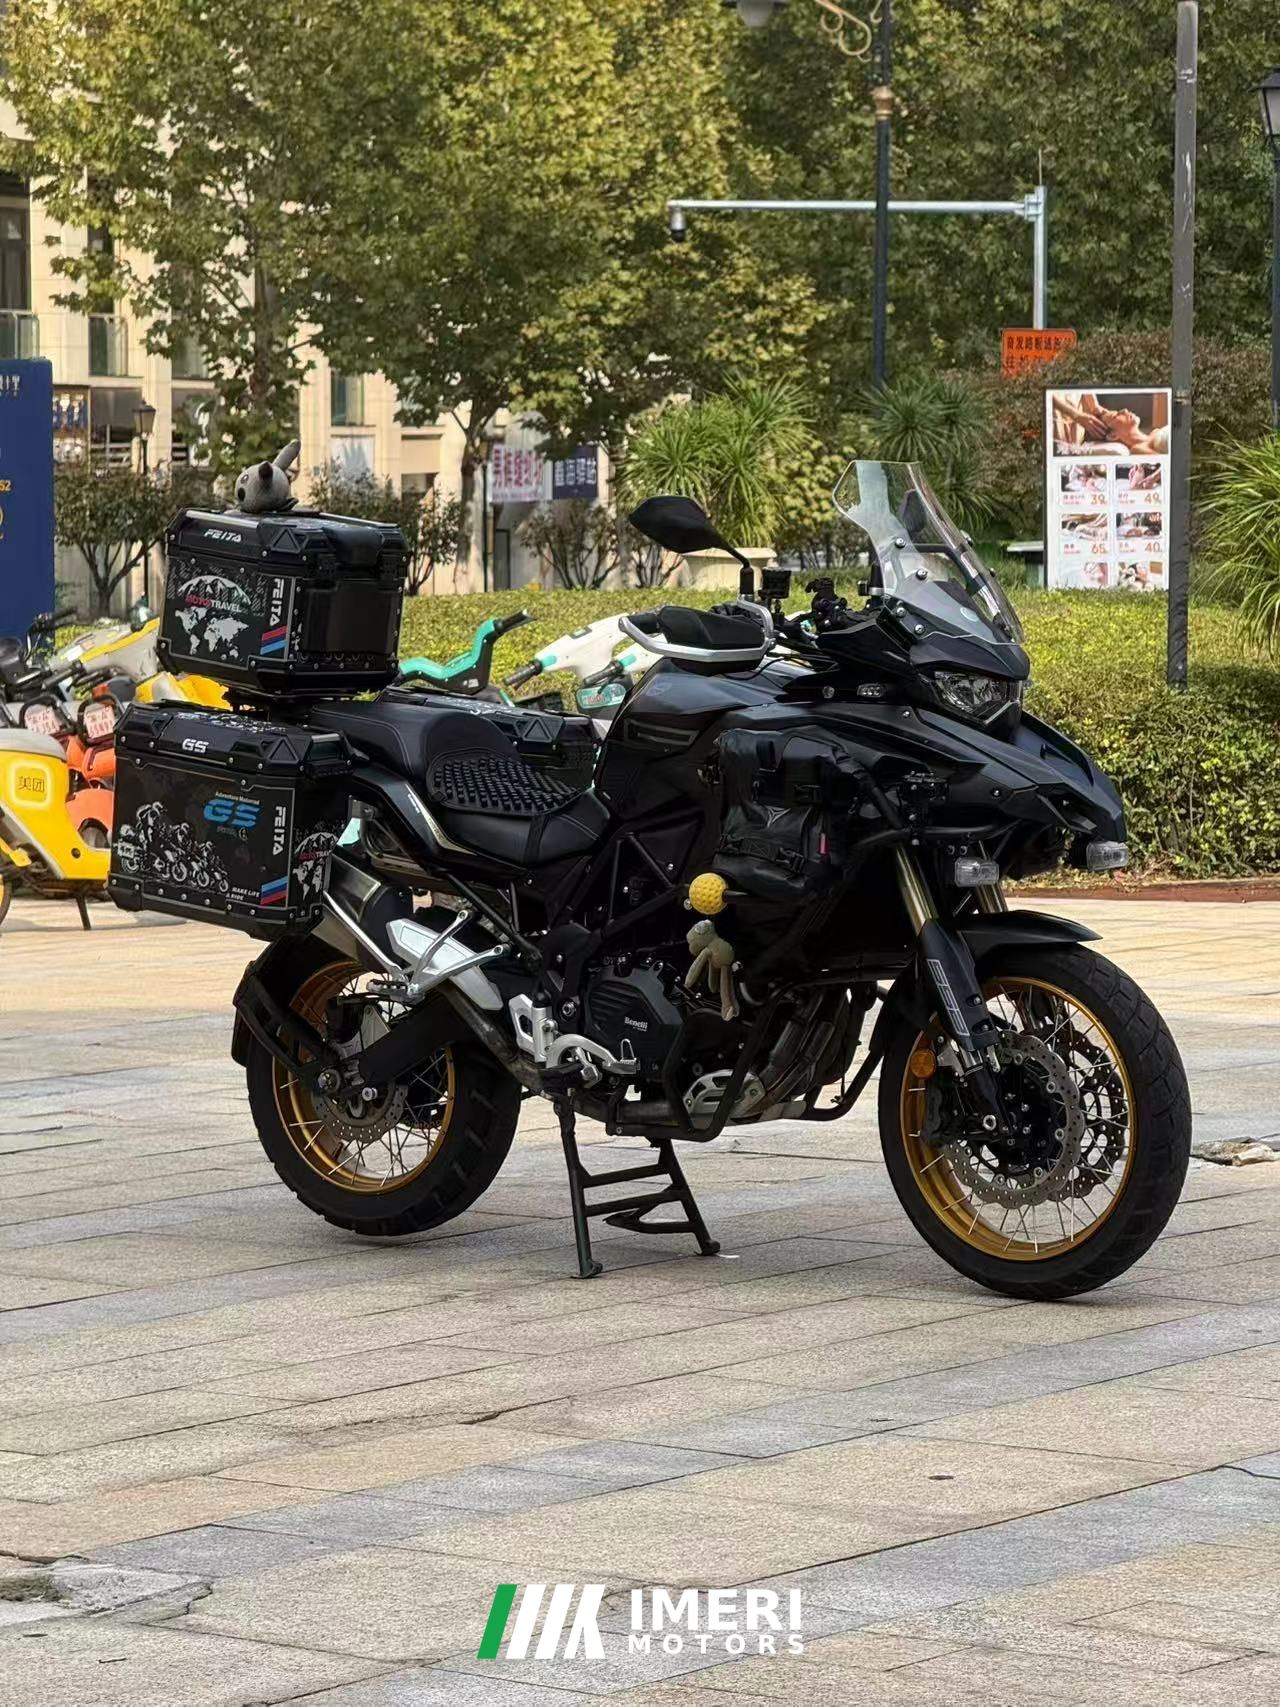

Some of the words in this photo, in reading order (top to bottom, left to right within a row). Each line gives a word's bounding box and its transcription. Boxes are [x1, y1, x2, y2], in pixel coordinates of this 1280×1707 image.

[204, 528, 242, 543] FEITA
[269, 578, 285, 627] FEITA
[182, 738, 209, 754] GS
[17, 775, 45, 793] 美团
[203, 798, 260, 828] GS
[272, 805, 287, 856] FEITA
[624, 1016, 648, 1029] Benelli
